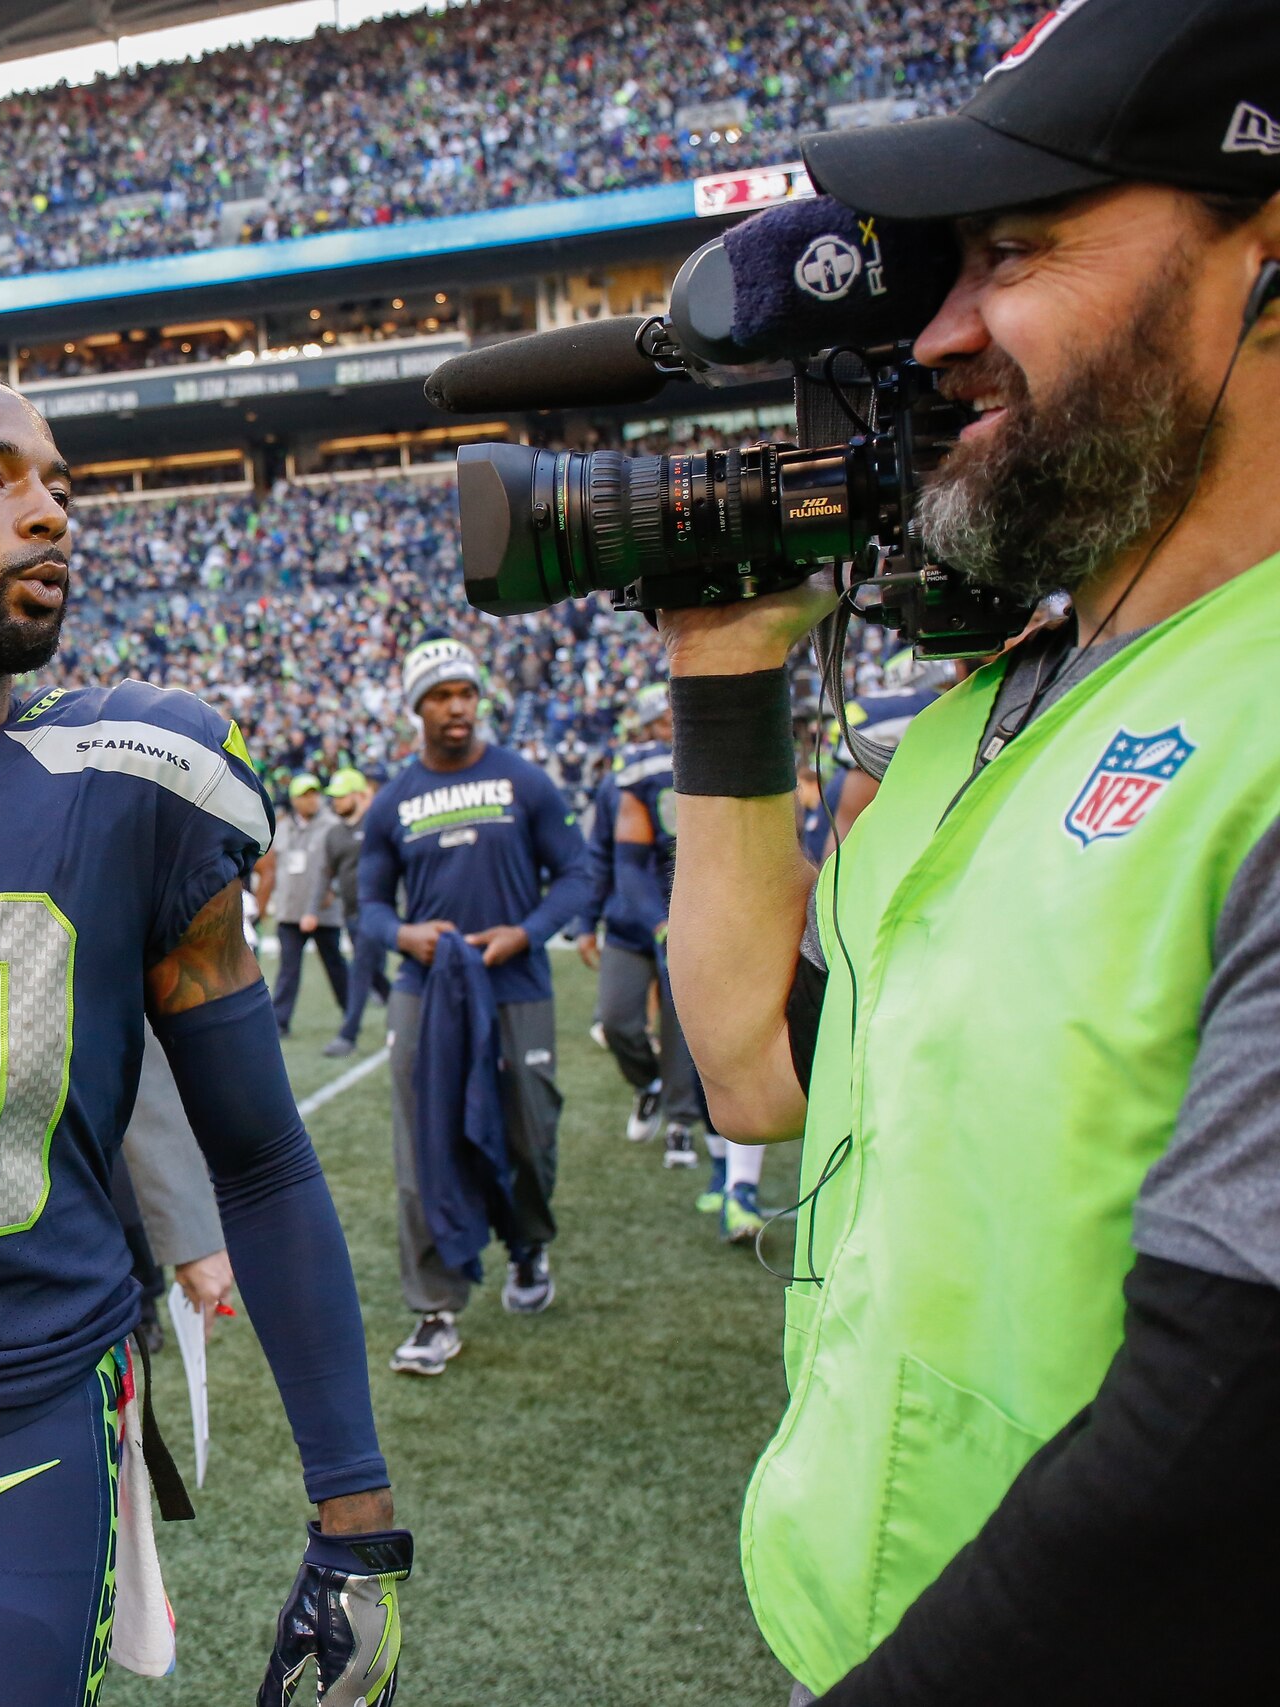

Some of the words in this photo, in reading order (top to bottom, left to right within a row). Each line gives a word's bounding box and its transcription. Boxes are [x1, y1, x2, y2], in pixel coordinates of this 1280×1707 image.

[789, 504, 842, 519] FUJINON
[802, 497, 828, 508] HD
[76, 739, 191, 772] SEAHAWKS
[397, 778, 514, 827] SEAHAWKS
[1074, 775, 1163, 831] NFL
